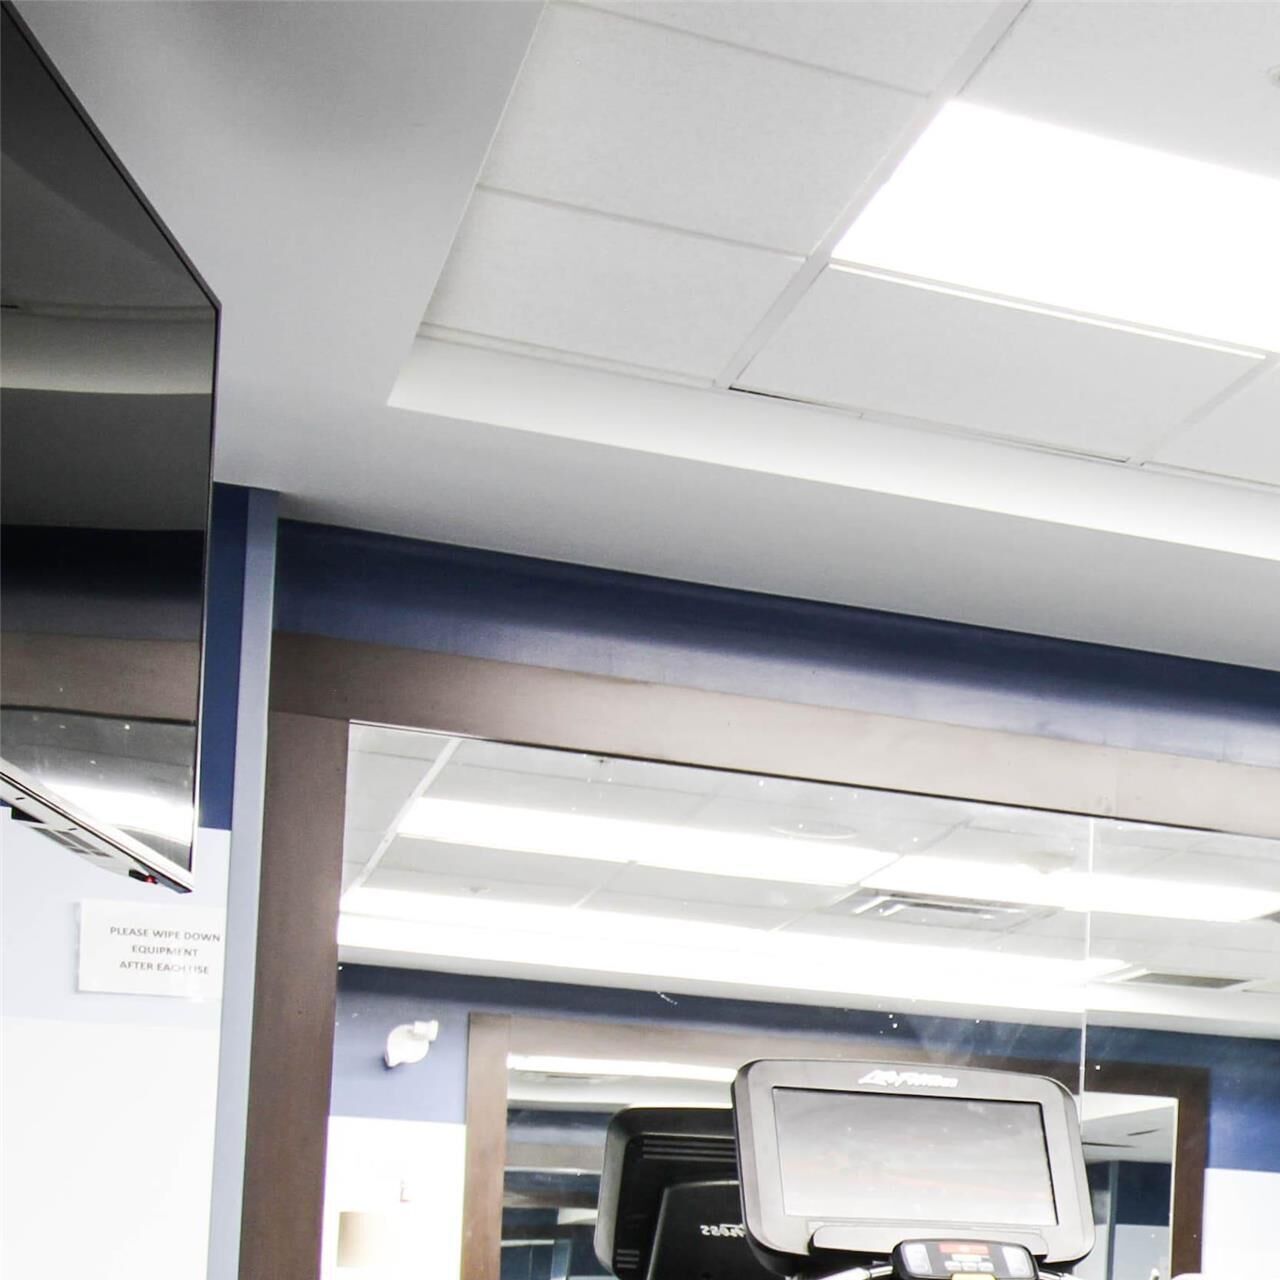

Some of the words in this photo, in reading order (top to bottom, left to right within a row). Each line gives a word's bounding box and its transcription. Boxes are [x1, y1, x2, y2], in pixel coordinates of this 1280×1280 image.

[110, 926, 149, 938] PLEASE
[152, 929, 180, 940] WIPE
[184, 931, 221, 942] DOWN
[119, 960, 154, 971] AFTER
